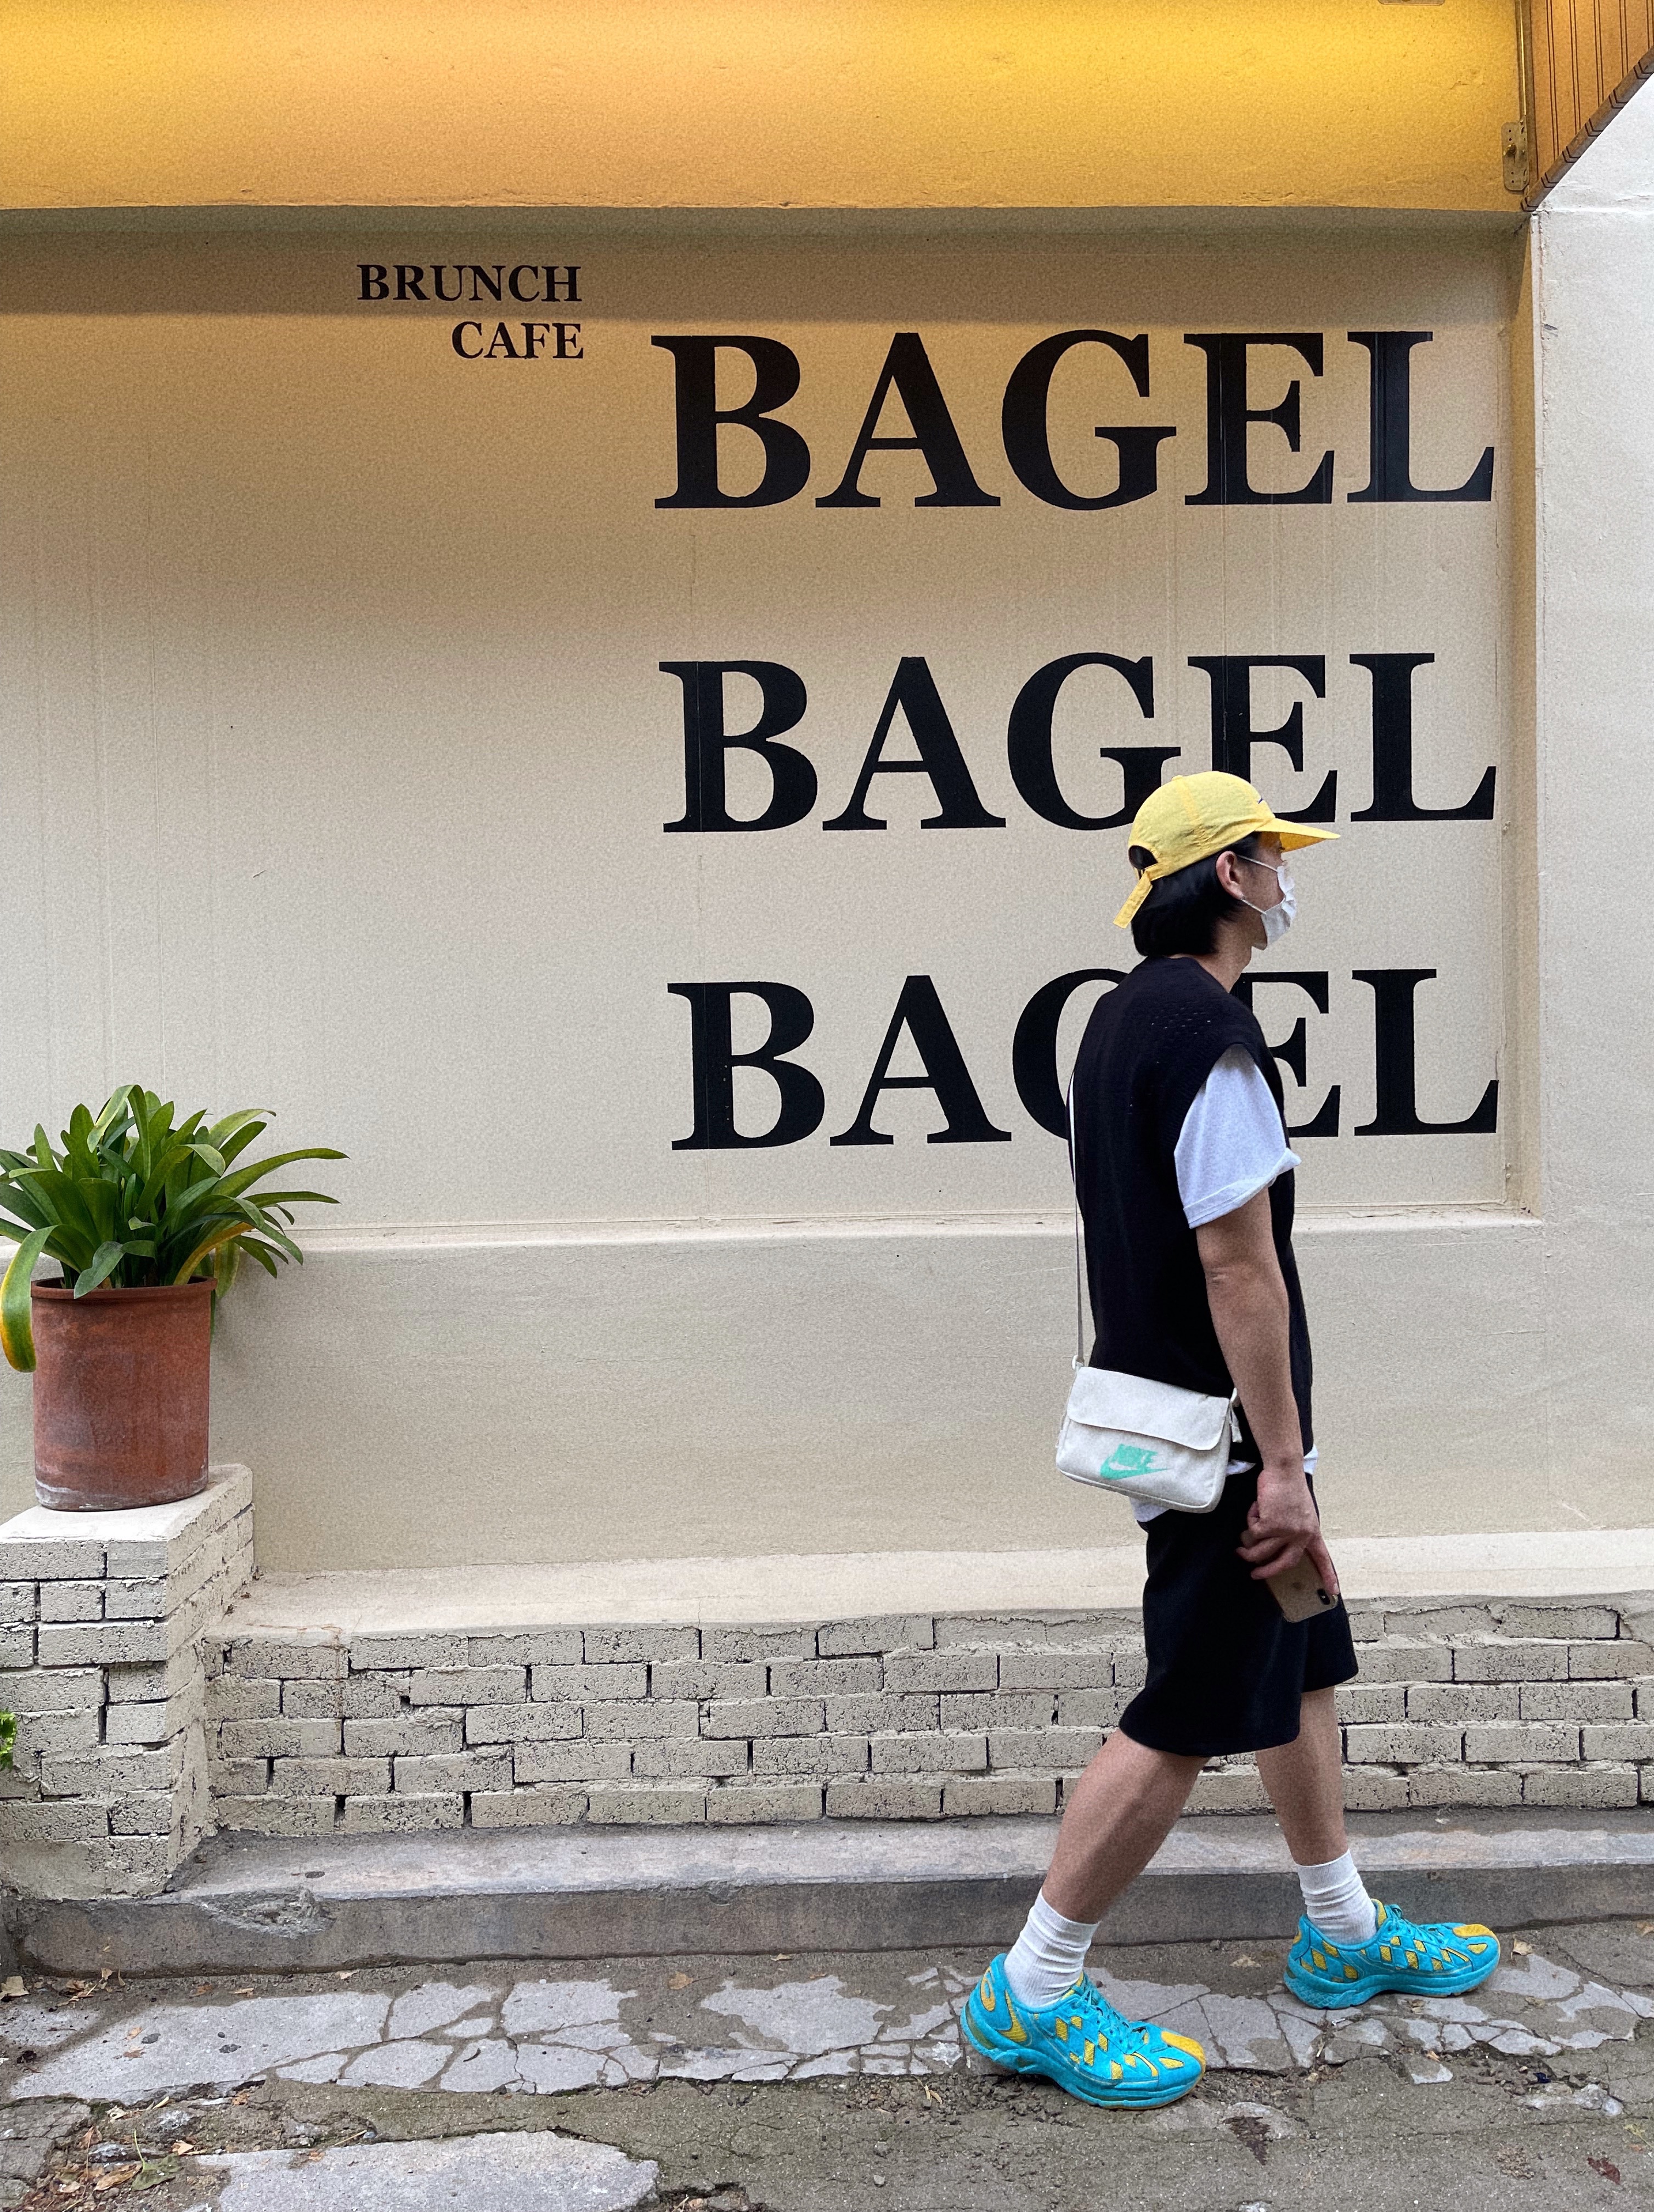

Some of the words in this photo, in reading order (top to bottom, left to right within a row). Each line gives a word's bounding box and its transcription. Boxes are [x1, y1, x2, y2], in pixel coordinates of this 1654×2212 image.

[356, 264, 583, 303] BRUNCH
[451, 321, 584, 359] CAFE
[651, 329, 1495, 510] BAGEL
[659, 651, 1497, 832] BAGEL
